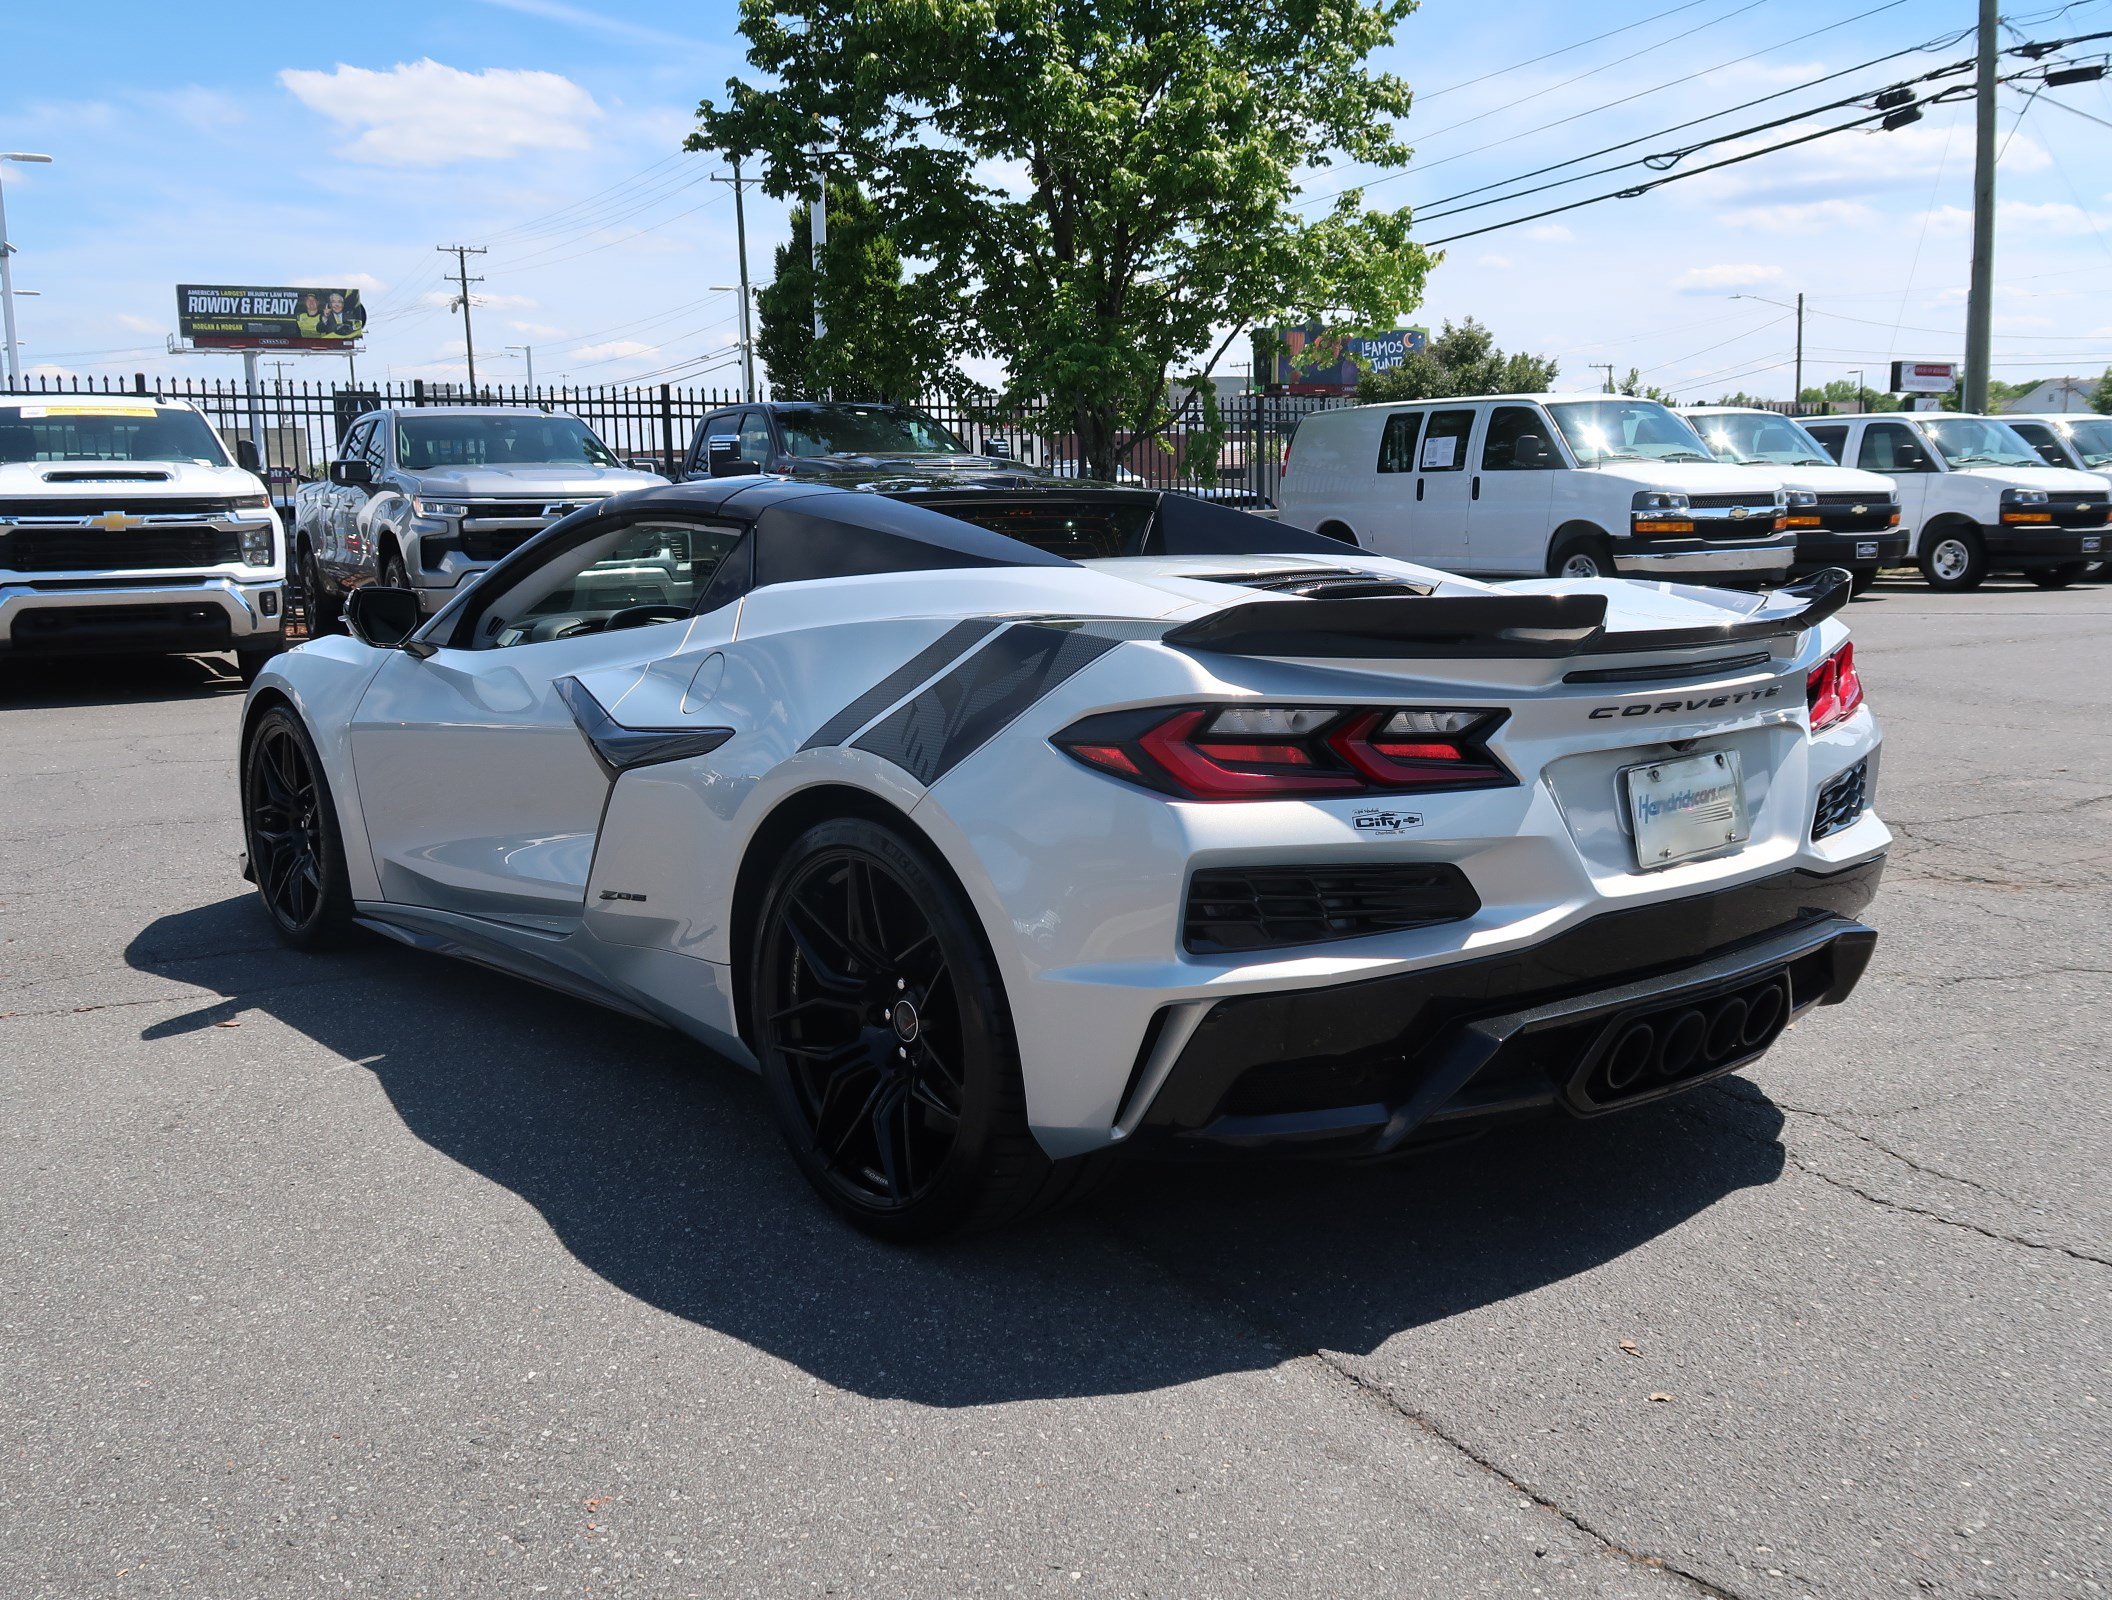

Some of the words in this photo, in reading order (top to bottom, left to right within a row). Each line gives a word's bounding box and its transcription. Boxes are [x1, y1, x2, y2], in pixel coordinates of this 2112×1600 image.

[188, 296, 240, 314] ROWDY
[241, 297, 251, 314] &
[253, 298, 298, 315] READY
[220, 323, 243, 331] MORGAN
[1361, 340, 1404, 357] LEAMOS
[1588, 684, 1783, 720] CORVETTE
[1356, 817, 1401, 828] City
